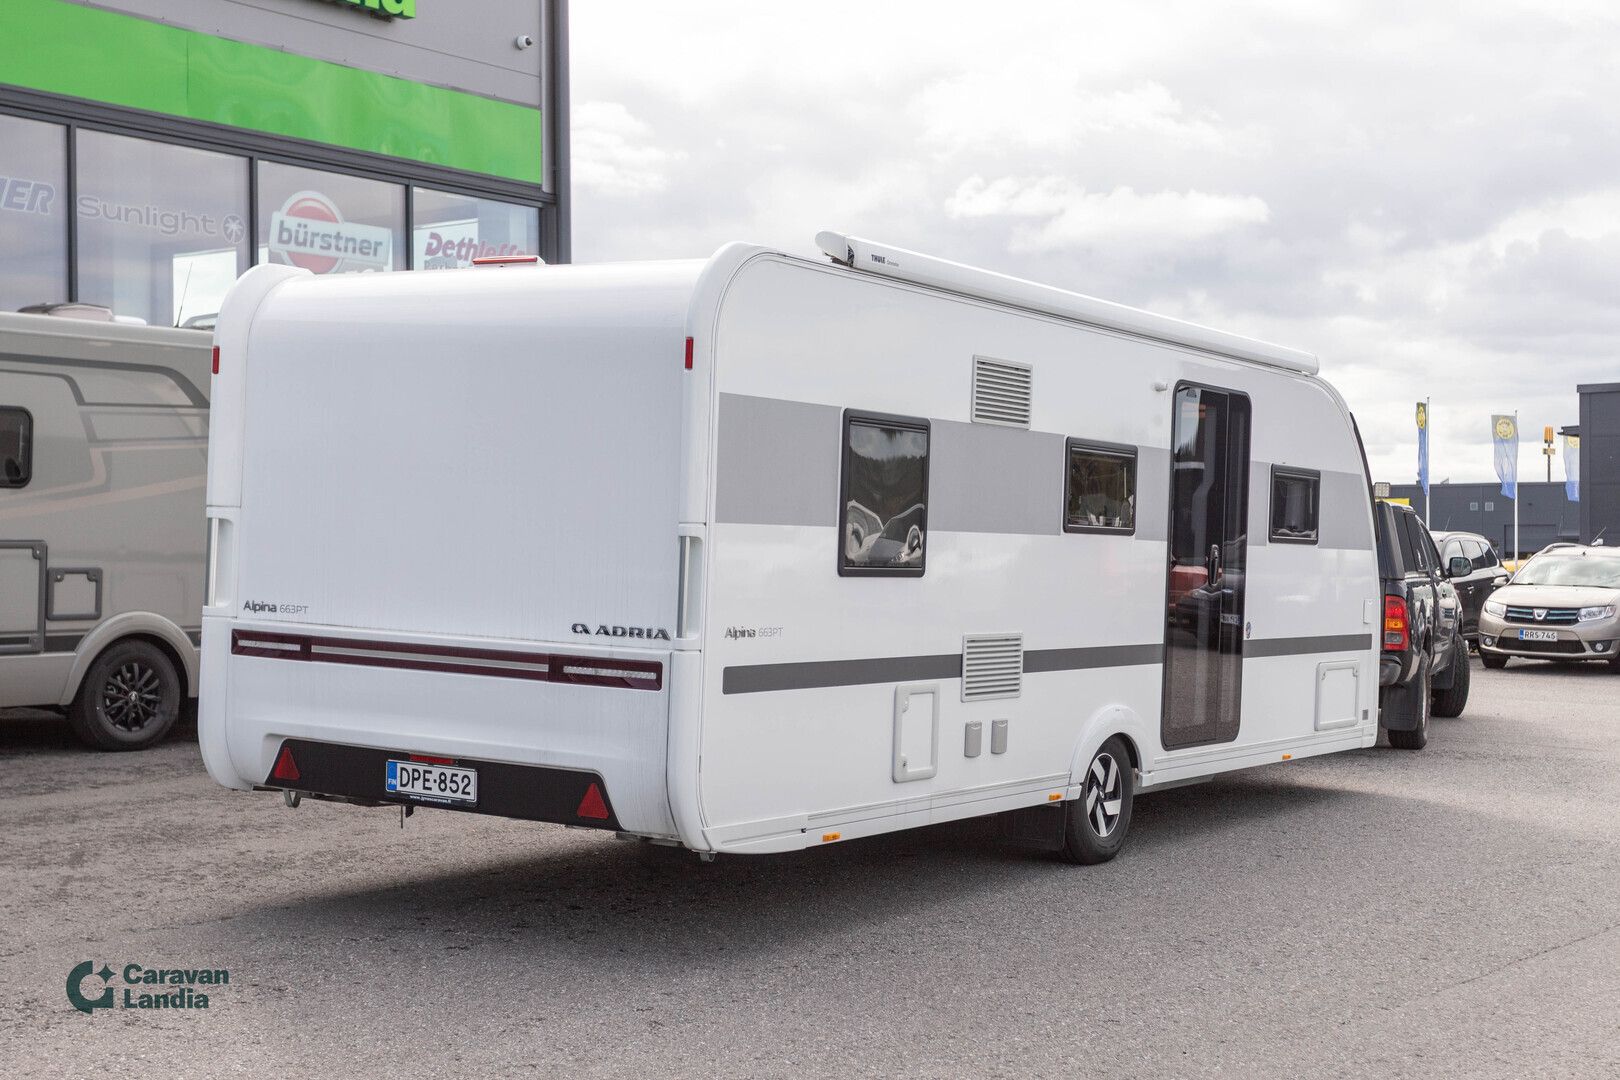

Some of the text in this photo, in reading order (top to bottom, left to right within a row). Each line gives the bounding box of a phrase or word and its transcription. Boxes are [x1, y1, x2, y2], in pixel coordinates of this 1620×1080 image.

[77, 196, 217, 235] Sunlight
[277, 219, 383, 257] bürstner
[243, 600, 309, 614] Alpina 663PT
[595, 624, 671, 641] ADRIA
[725, 626, 784, 640] Alpina 663PT
[400, 767, 471, 795] DPE-852
